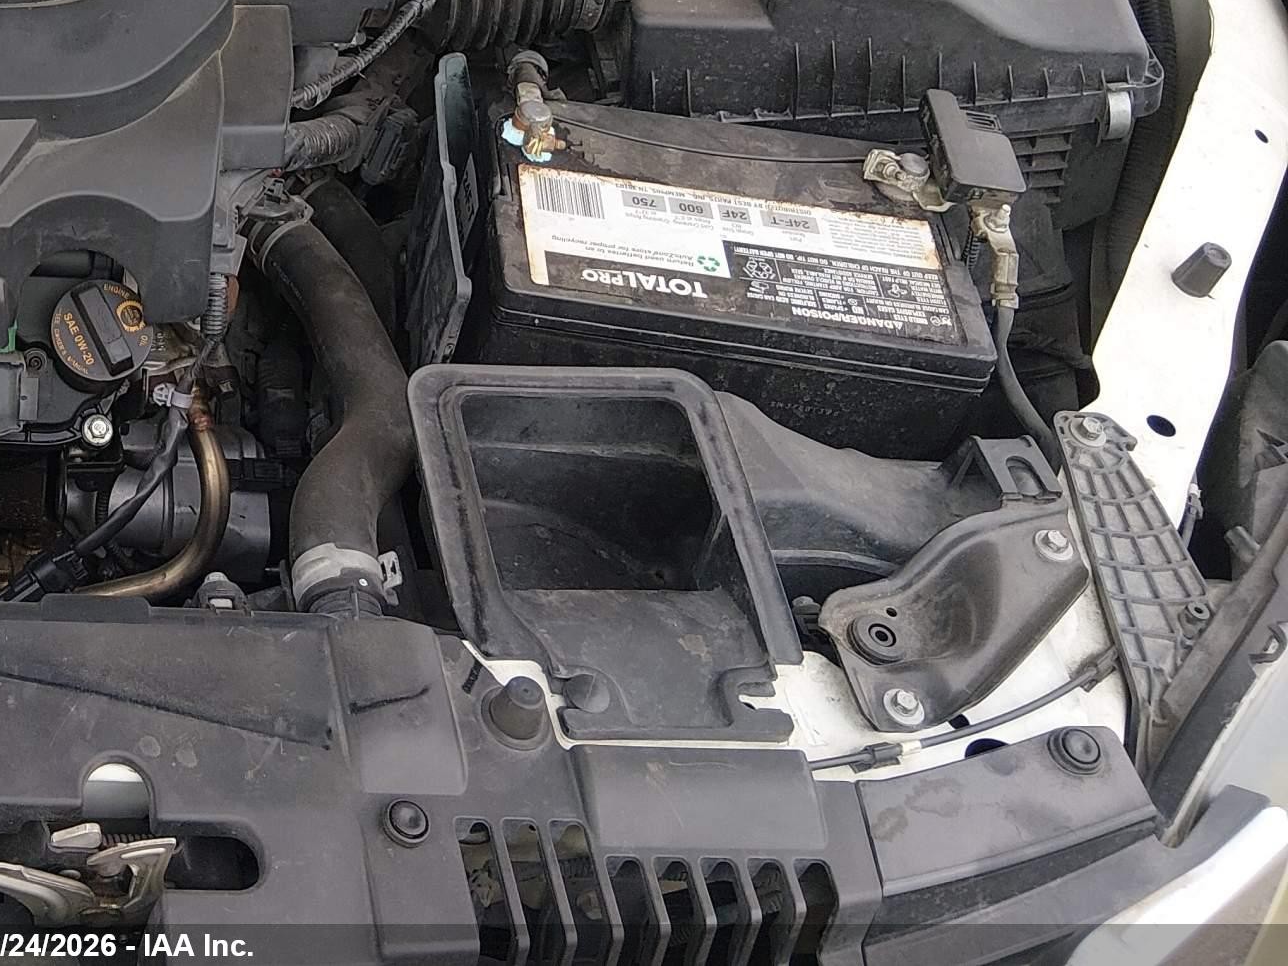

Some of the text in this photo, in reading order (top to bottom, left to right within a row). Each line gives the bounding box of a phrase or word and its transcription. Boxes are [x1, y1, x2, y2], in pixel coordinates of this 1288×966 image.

[630, 195, 657, 208] 750
[677, 201, 704, 214] 600
[720, 208, 748, 221] 24F
[768, 214, 810, 229] 24F-T
[550, 233, 588, 245] recycling
[589, 239, 616, 249] proper
[606, 248, 643, 260] batteries
[616, 244, 629, 252] for
[629, 246, 652, 254] store
[644, 253, 665, 262] used
[665, 256, 694, 267] Return
[579, 264, 708, 299] TOTALPRO
[103, 283, 130, 298] ENGINE
[790, 305, 895, 330] DANGER/POISON
[64, 313, 95, 365] SAE 0W-20
